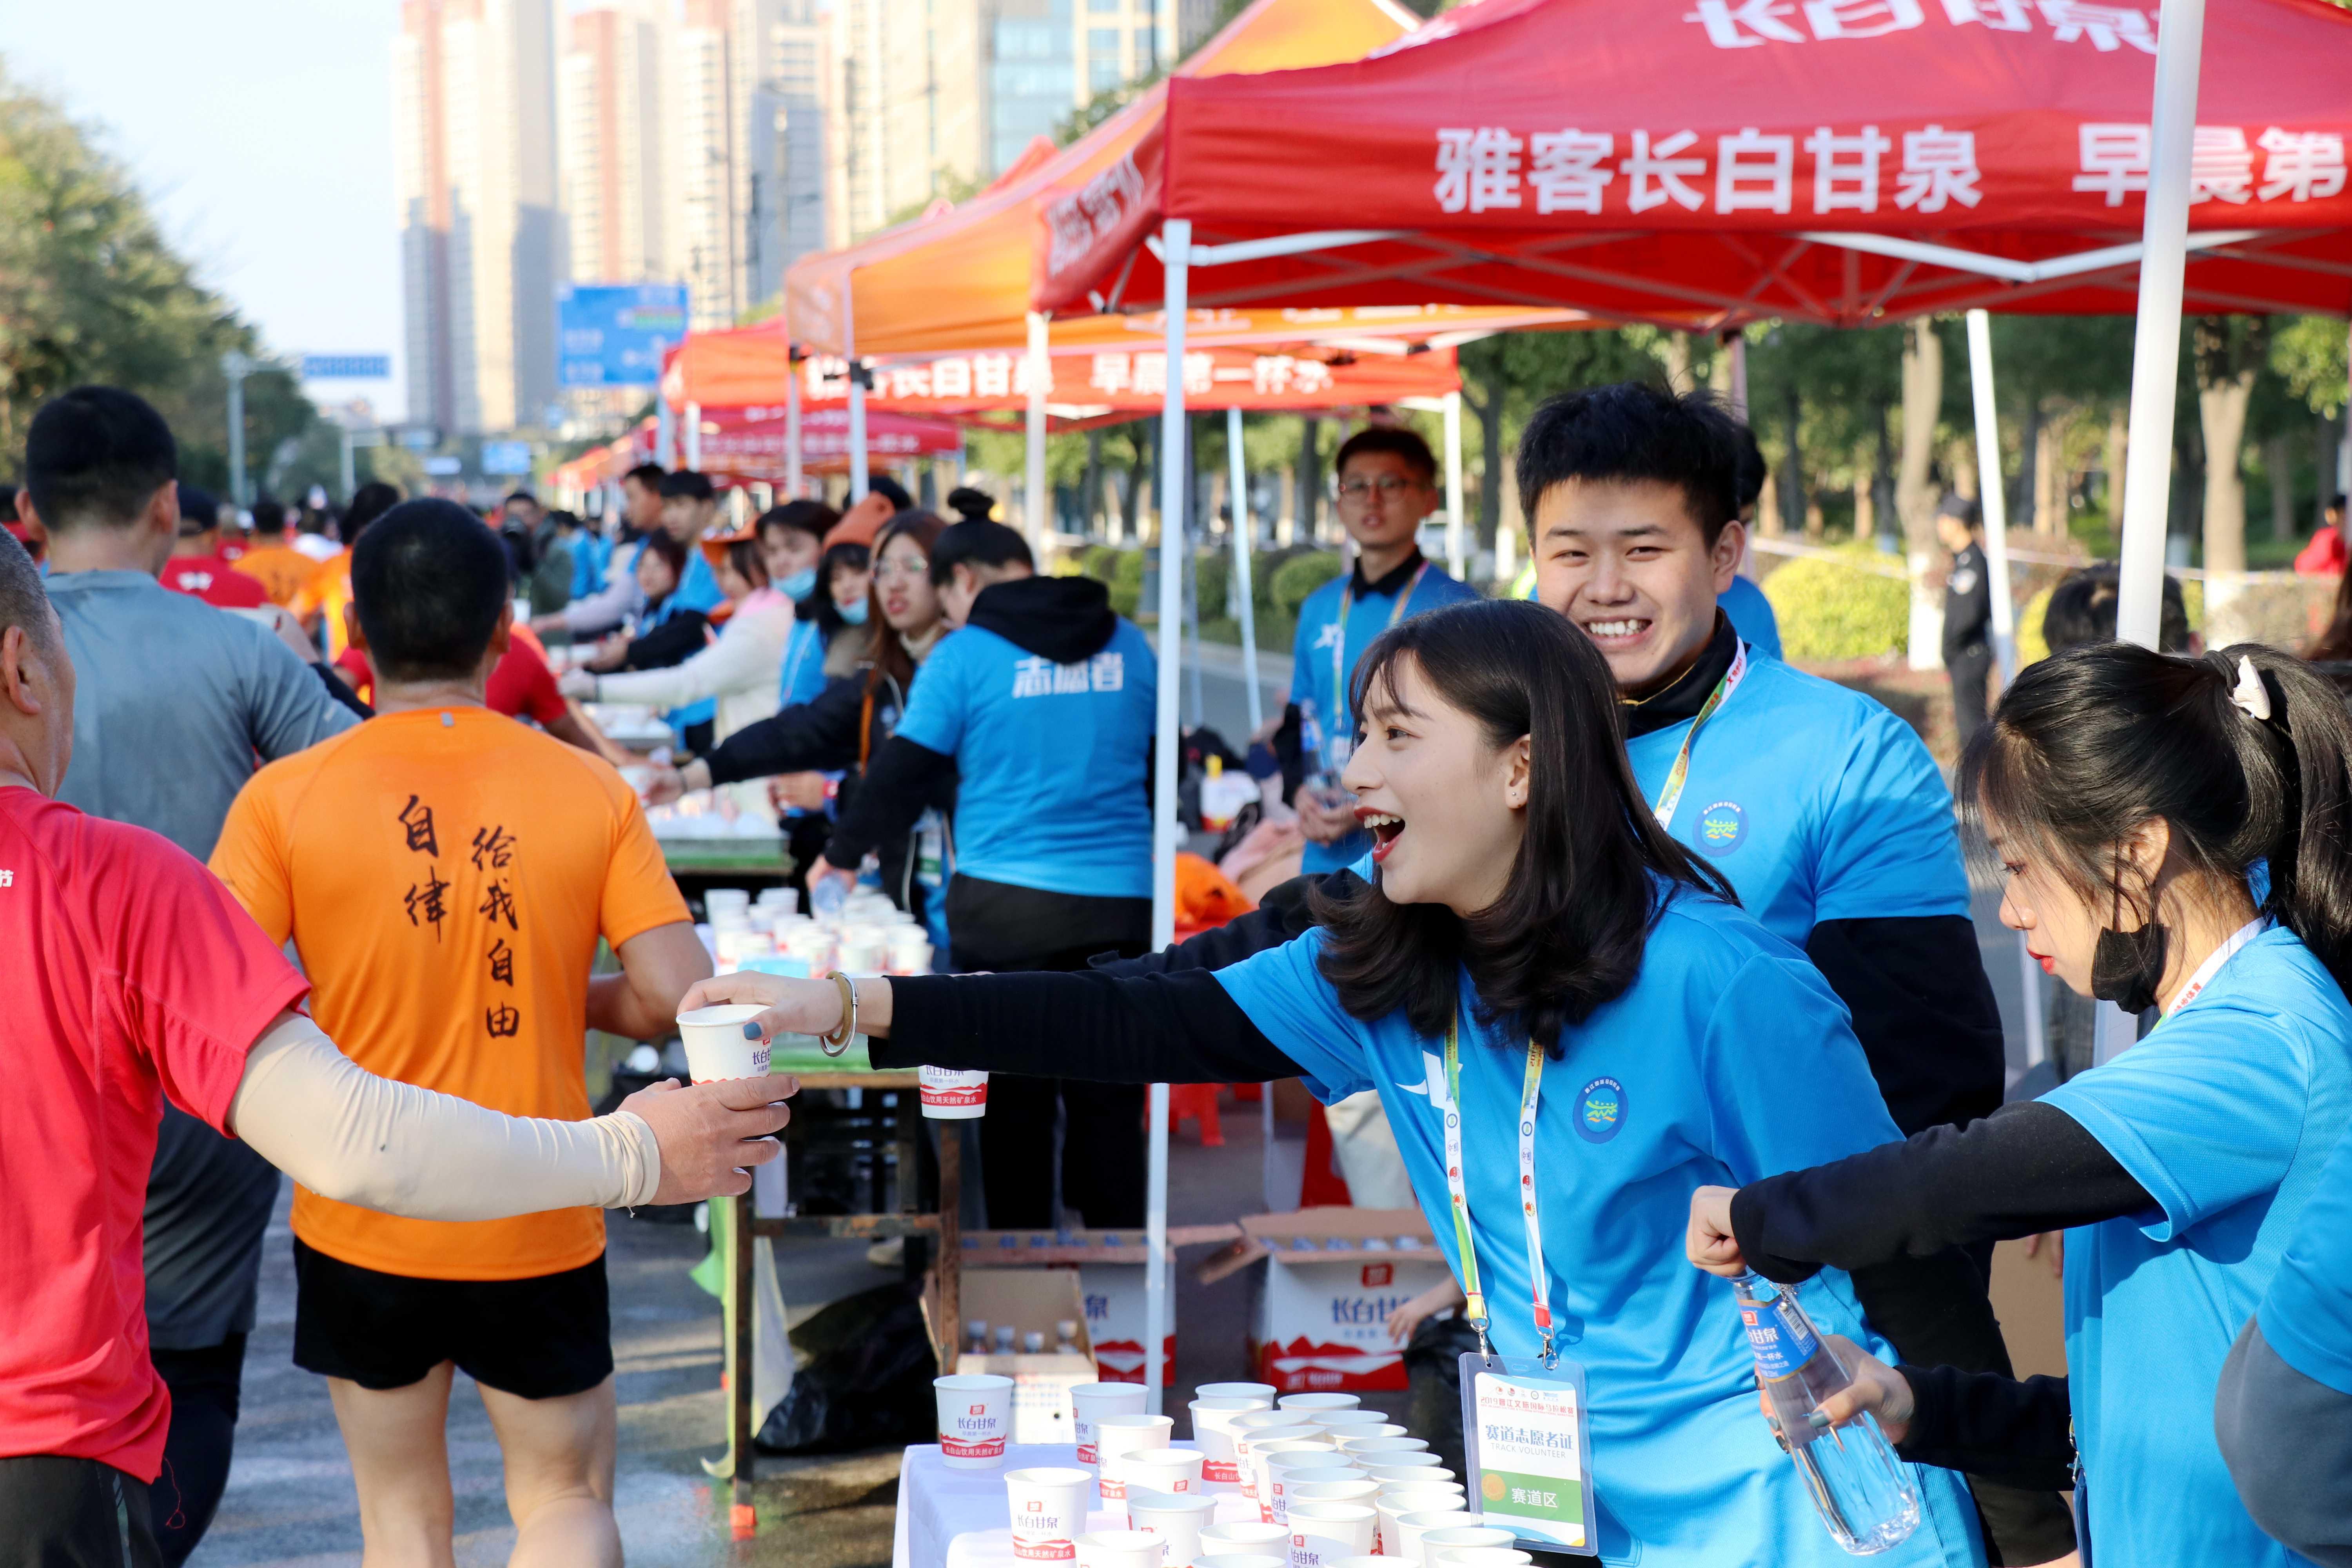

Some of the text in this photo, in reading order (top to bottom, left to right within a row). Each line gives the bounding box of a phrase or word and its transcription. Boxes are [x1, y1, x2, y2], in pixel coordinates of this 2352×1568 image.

[1434, 125, 1982, 215] 雅客长白甘泉
[398, 794, 451, 943] 自律
[471, 825, 519, 1038] 给我自由
[1333, 1297, 1410, 1324] 长白甘
[957, 1417, 996, 1430] 长白甘泉
[1485, 1424, 1574, 1450] 赛道志愿者证
[946, 1446, 1003, 1456] 长白山饮用天然矿泉水
[1491, 1443, 1566, 1459] TRACK VOLUNTEER
[1512, 1487, 1558, 1508] 赛道区
[1017, 1514, 1058, 1529] 长白甘泉
